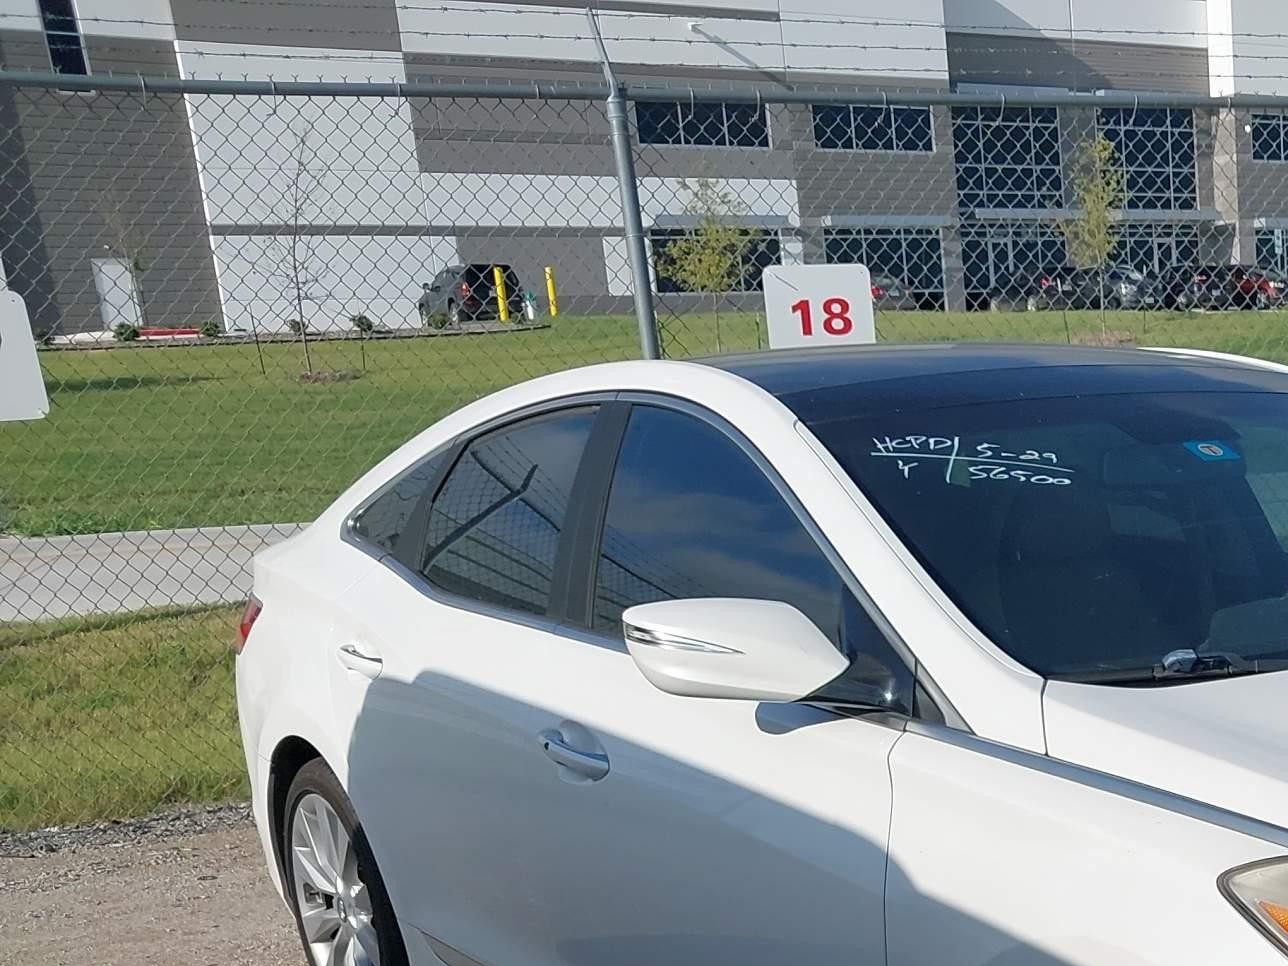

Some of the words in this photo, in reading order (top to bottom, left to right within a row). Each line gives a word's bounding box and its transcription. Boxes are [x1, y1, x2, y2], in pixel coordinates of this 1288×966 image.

[791, 298, 853, 336] 18
[976, 443, 1058, 463] 5-29
[968, 465, 1072, 485] 56500
